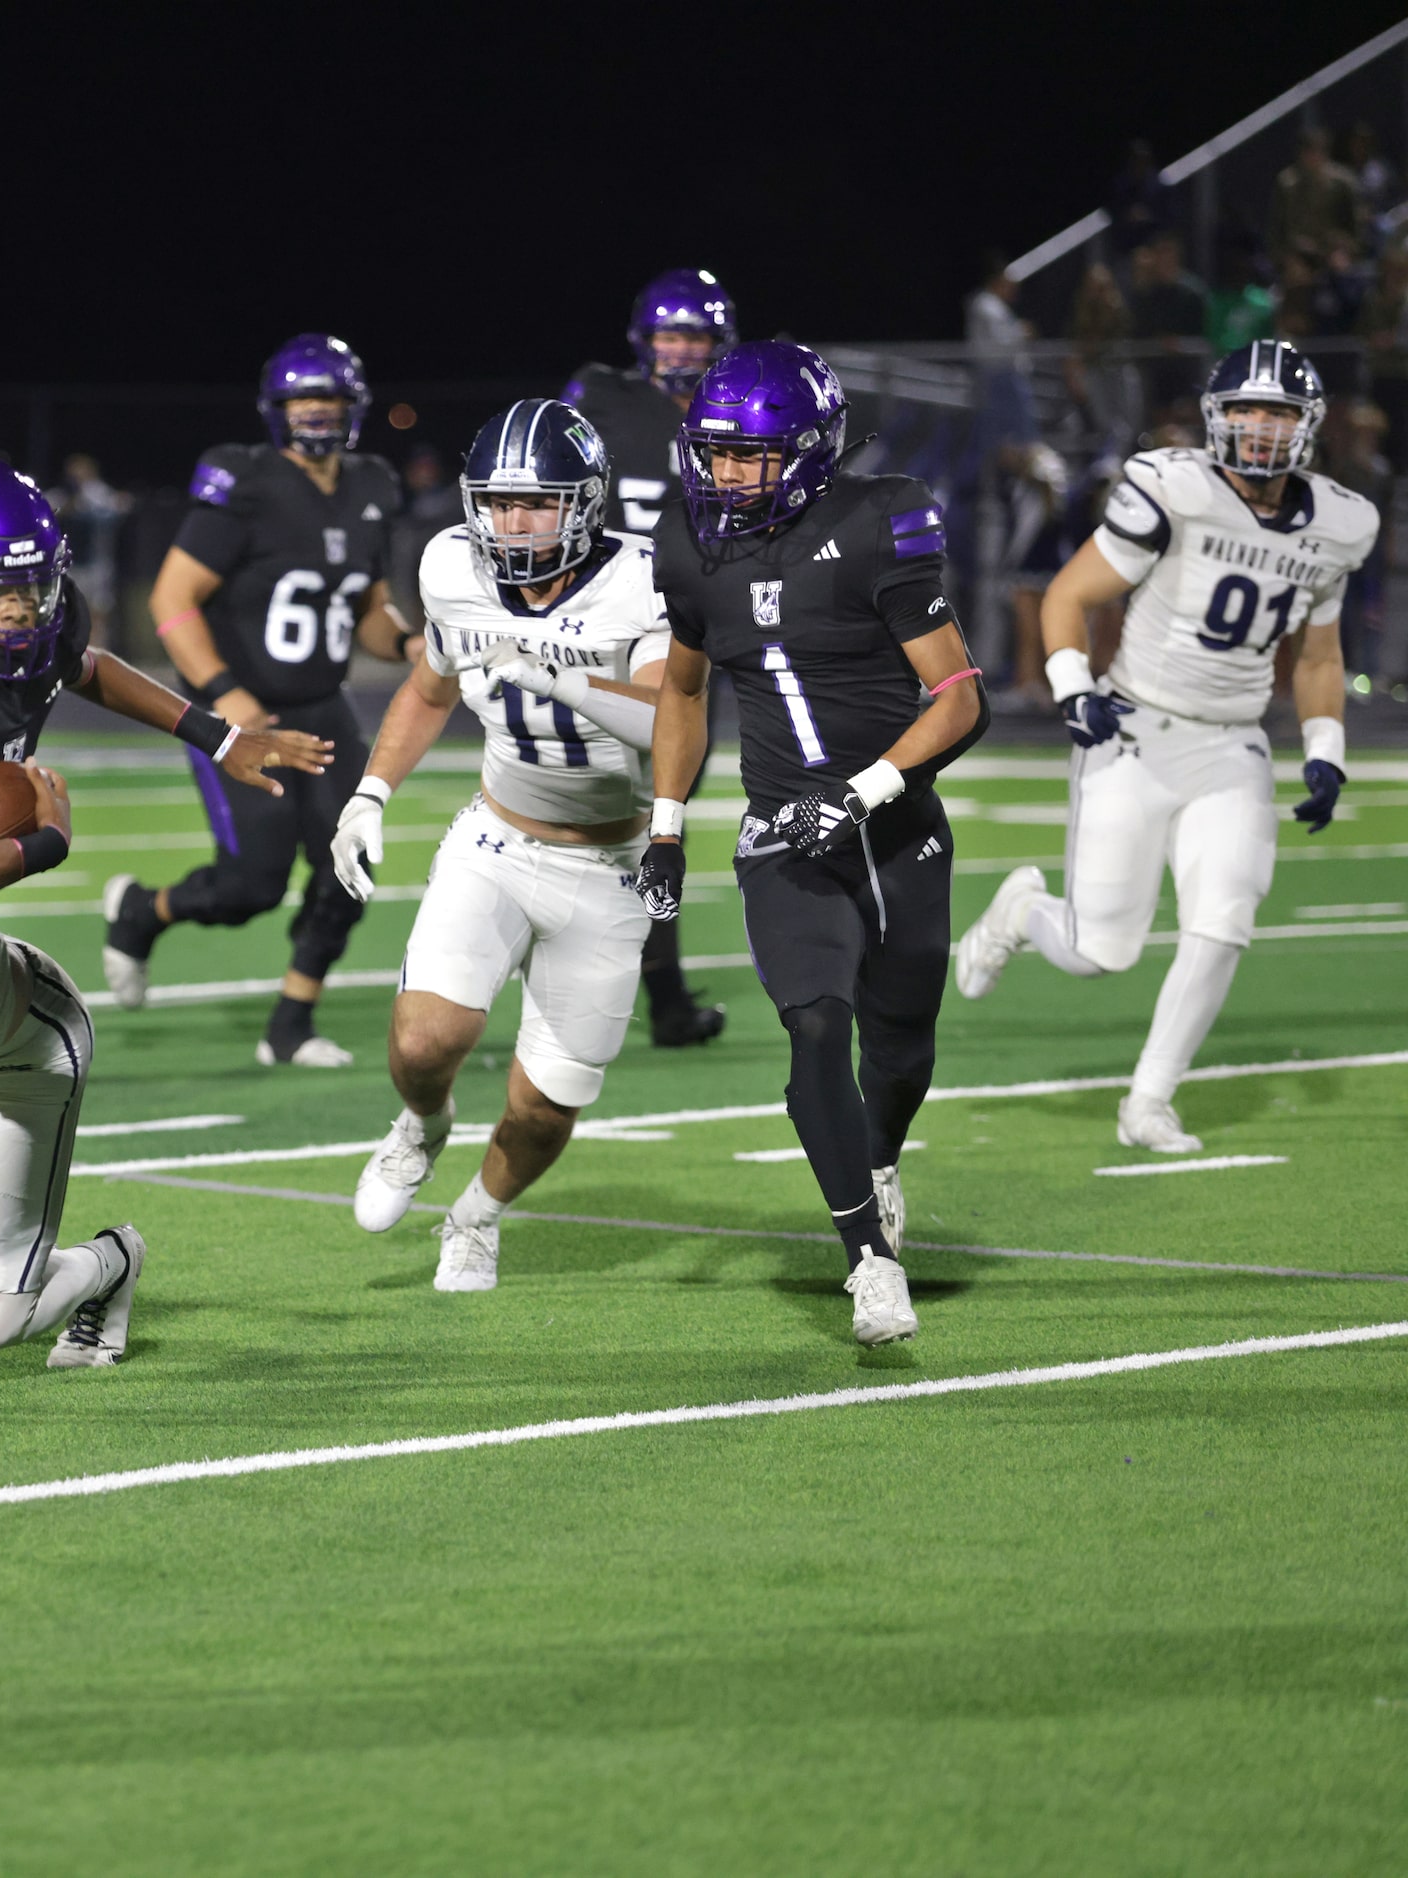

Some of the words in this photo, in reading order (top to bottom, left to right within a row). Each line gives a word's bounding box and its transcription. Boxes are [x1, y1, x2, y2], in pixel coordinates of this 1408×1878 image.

[265, 569, 371, 664] 66
[541, 641, 603, 667] GROVE
[1196, 574, 1298, 655] 91
[488, 679, 590, 767] 11
[761, 642, 831, 768] 1
